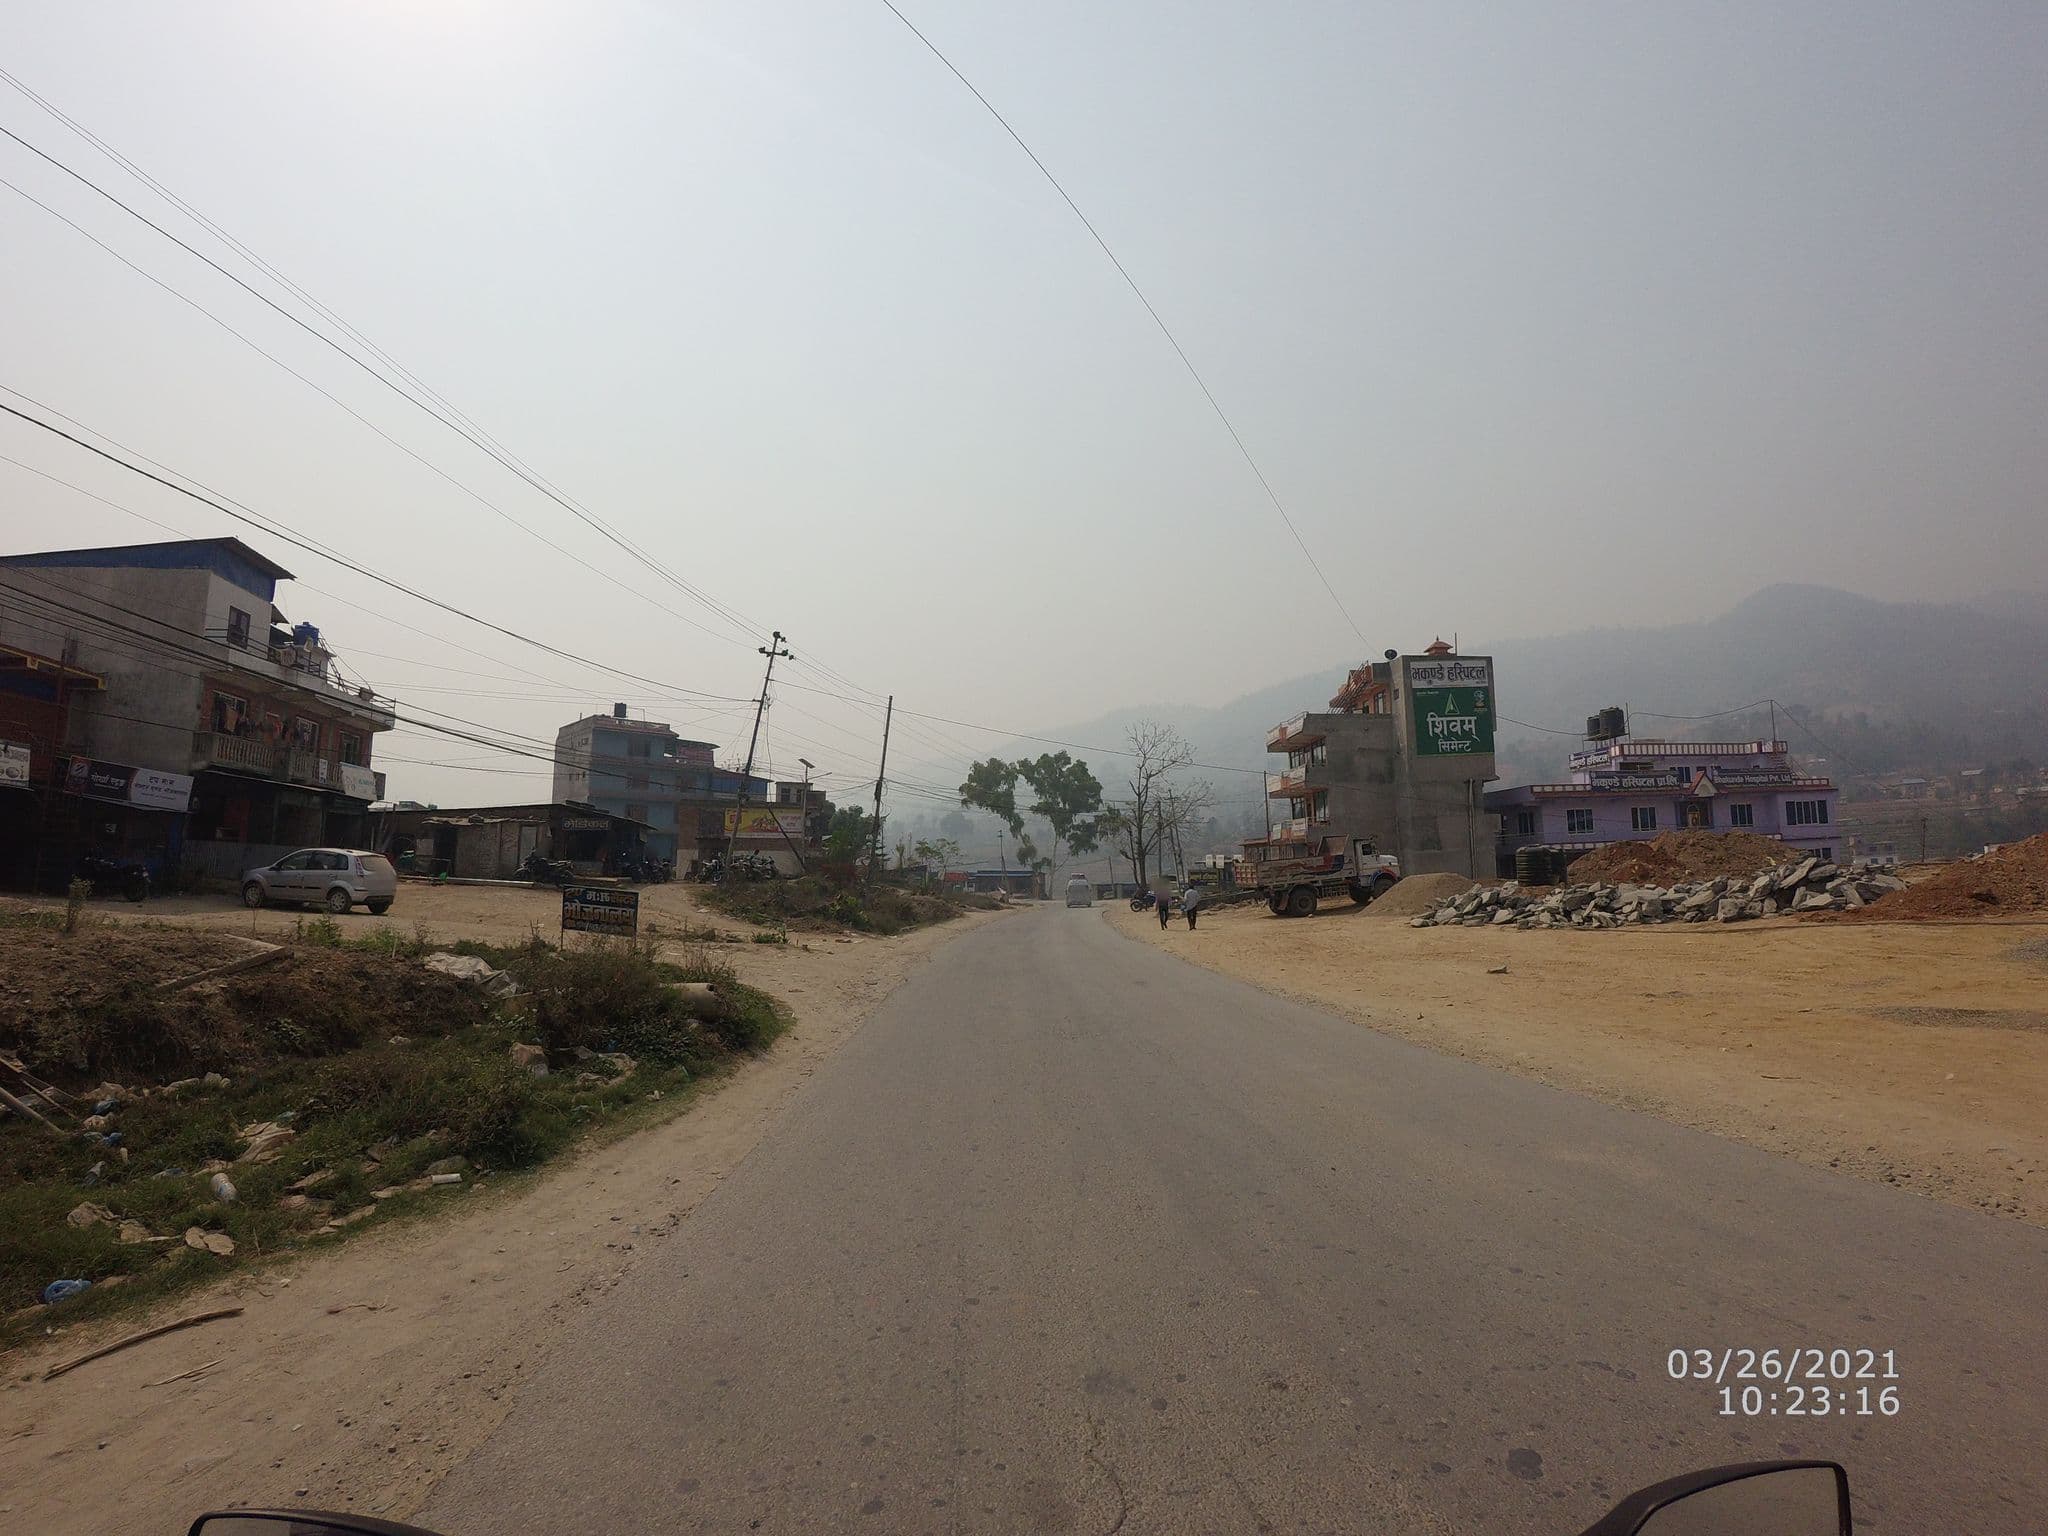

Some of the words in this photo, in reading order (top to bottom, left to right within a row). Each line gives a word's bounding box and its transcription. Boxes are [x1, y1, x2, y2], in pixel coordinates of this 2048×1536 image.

[1426, 712, 1480, 741] शिवम्
[1438, 737, 1471, 753] सिमेन्ट
[1745, 774, 1768, 783] Hospital
